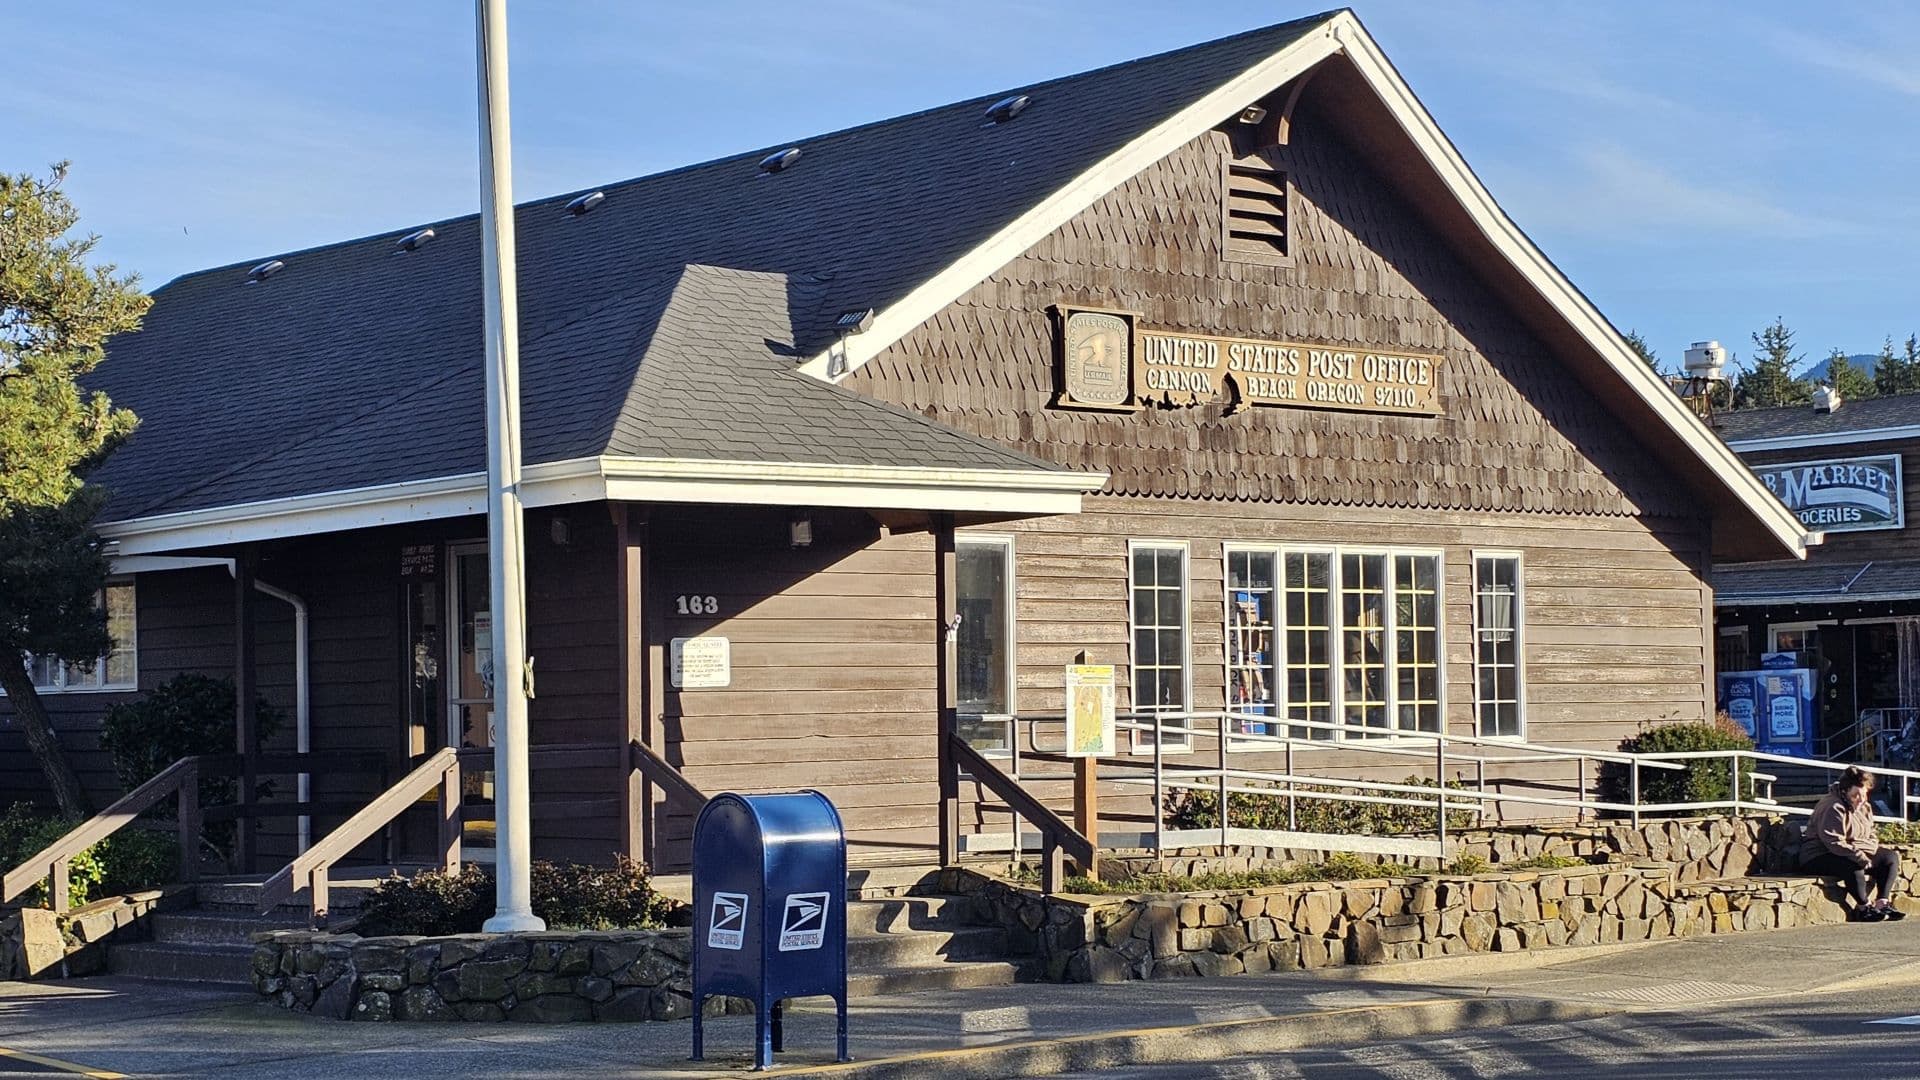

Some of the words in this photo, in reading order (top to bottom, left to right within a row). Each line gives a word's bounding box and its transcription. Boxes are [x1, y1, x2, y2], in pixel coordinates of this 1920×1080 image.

[1144, 336, 1219, 369] UNITED
[1228, 344, 1299, 376] STATES
[1307, 350, 1357, 380] POST
[1362, 354, 1431, 386] OFFICE
[1146, 368, 1212, 394] CANNON
[1246, 376, 1298, 400] BEACH
[1306, 380, 1365, 405] OREGON
[1374, 387, 1416, 408] 97110
[1781, 464, 1890, 509] MARKET
[1797, 506, 1862, 525] OCERIES
[676, 595, 718, 615] 163
